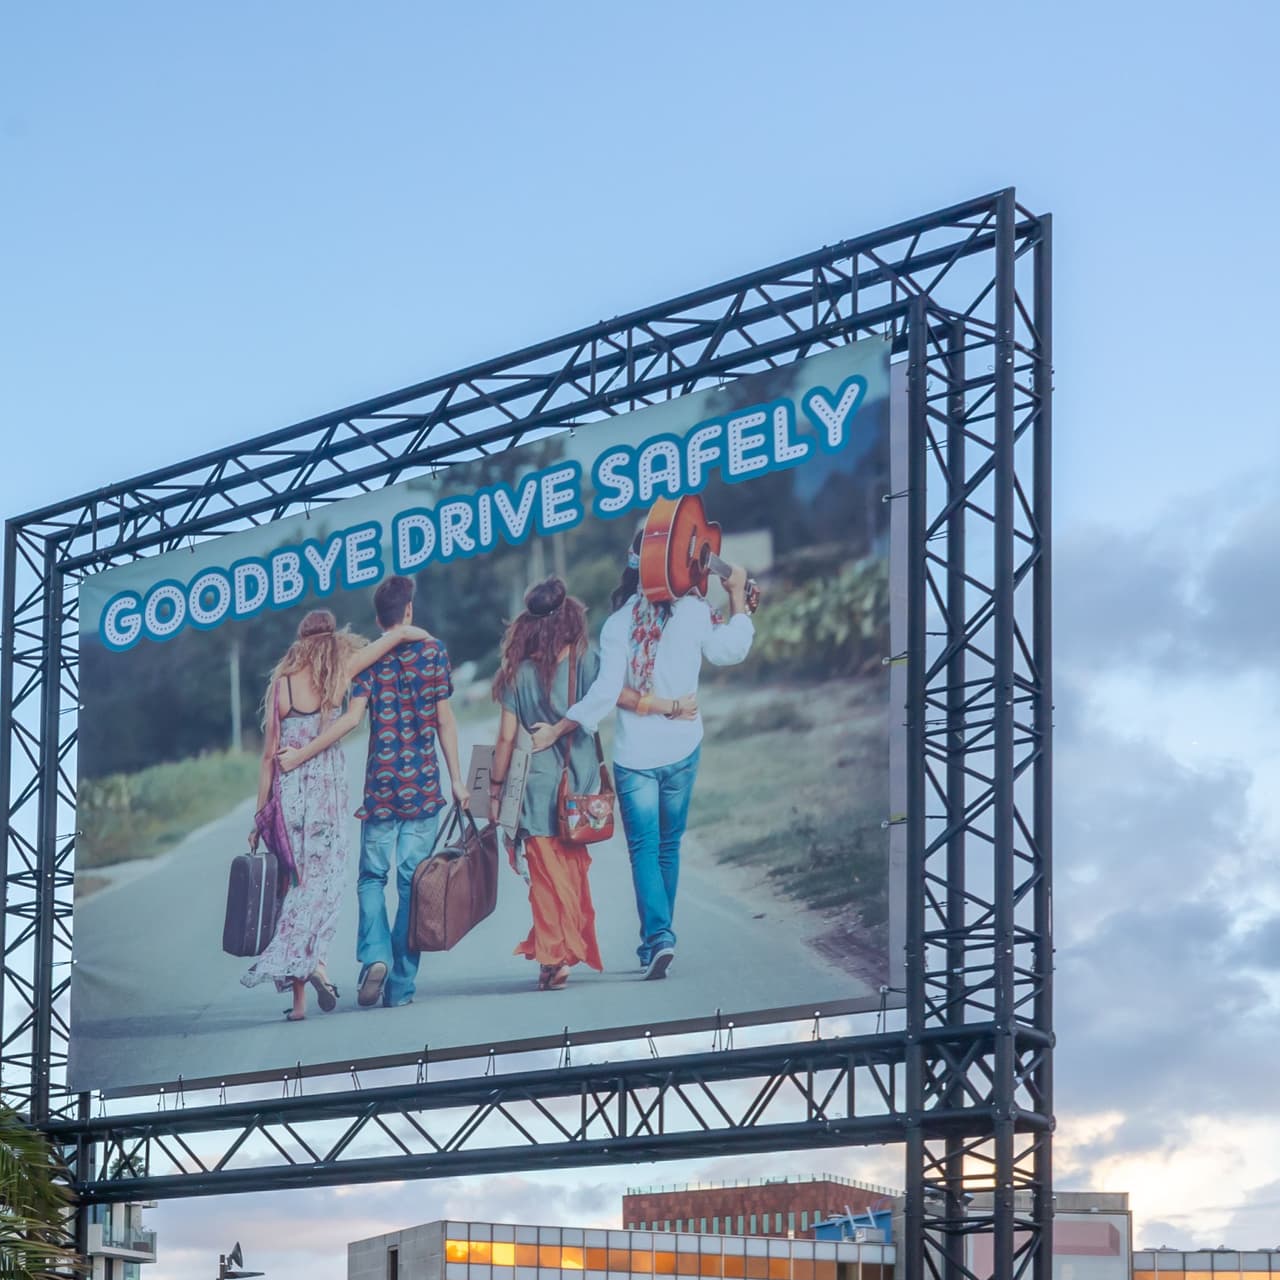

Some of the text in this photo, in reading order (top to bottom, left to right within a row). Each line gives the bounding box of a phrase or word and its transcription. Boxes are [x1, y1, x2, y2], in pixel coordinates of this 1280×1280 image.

[104, 382, 861, 646] GOODBYE DRIVE SAFELY
